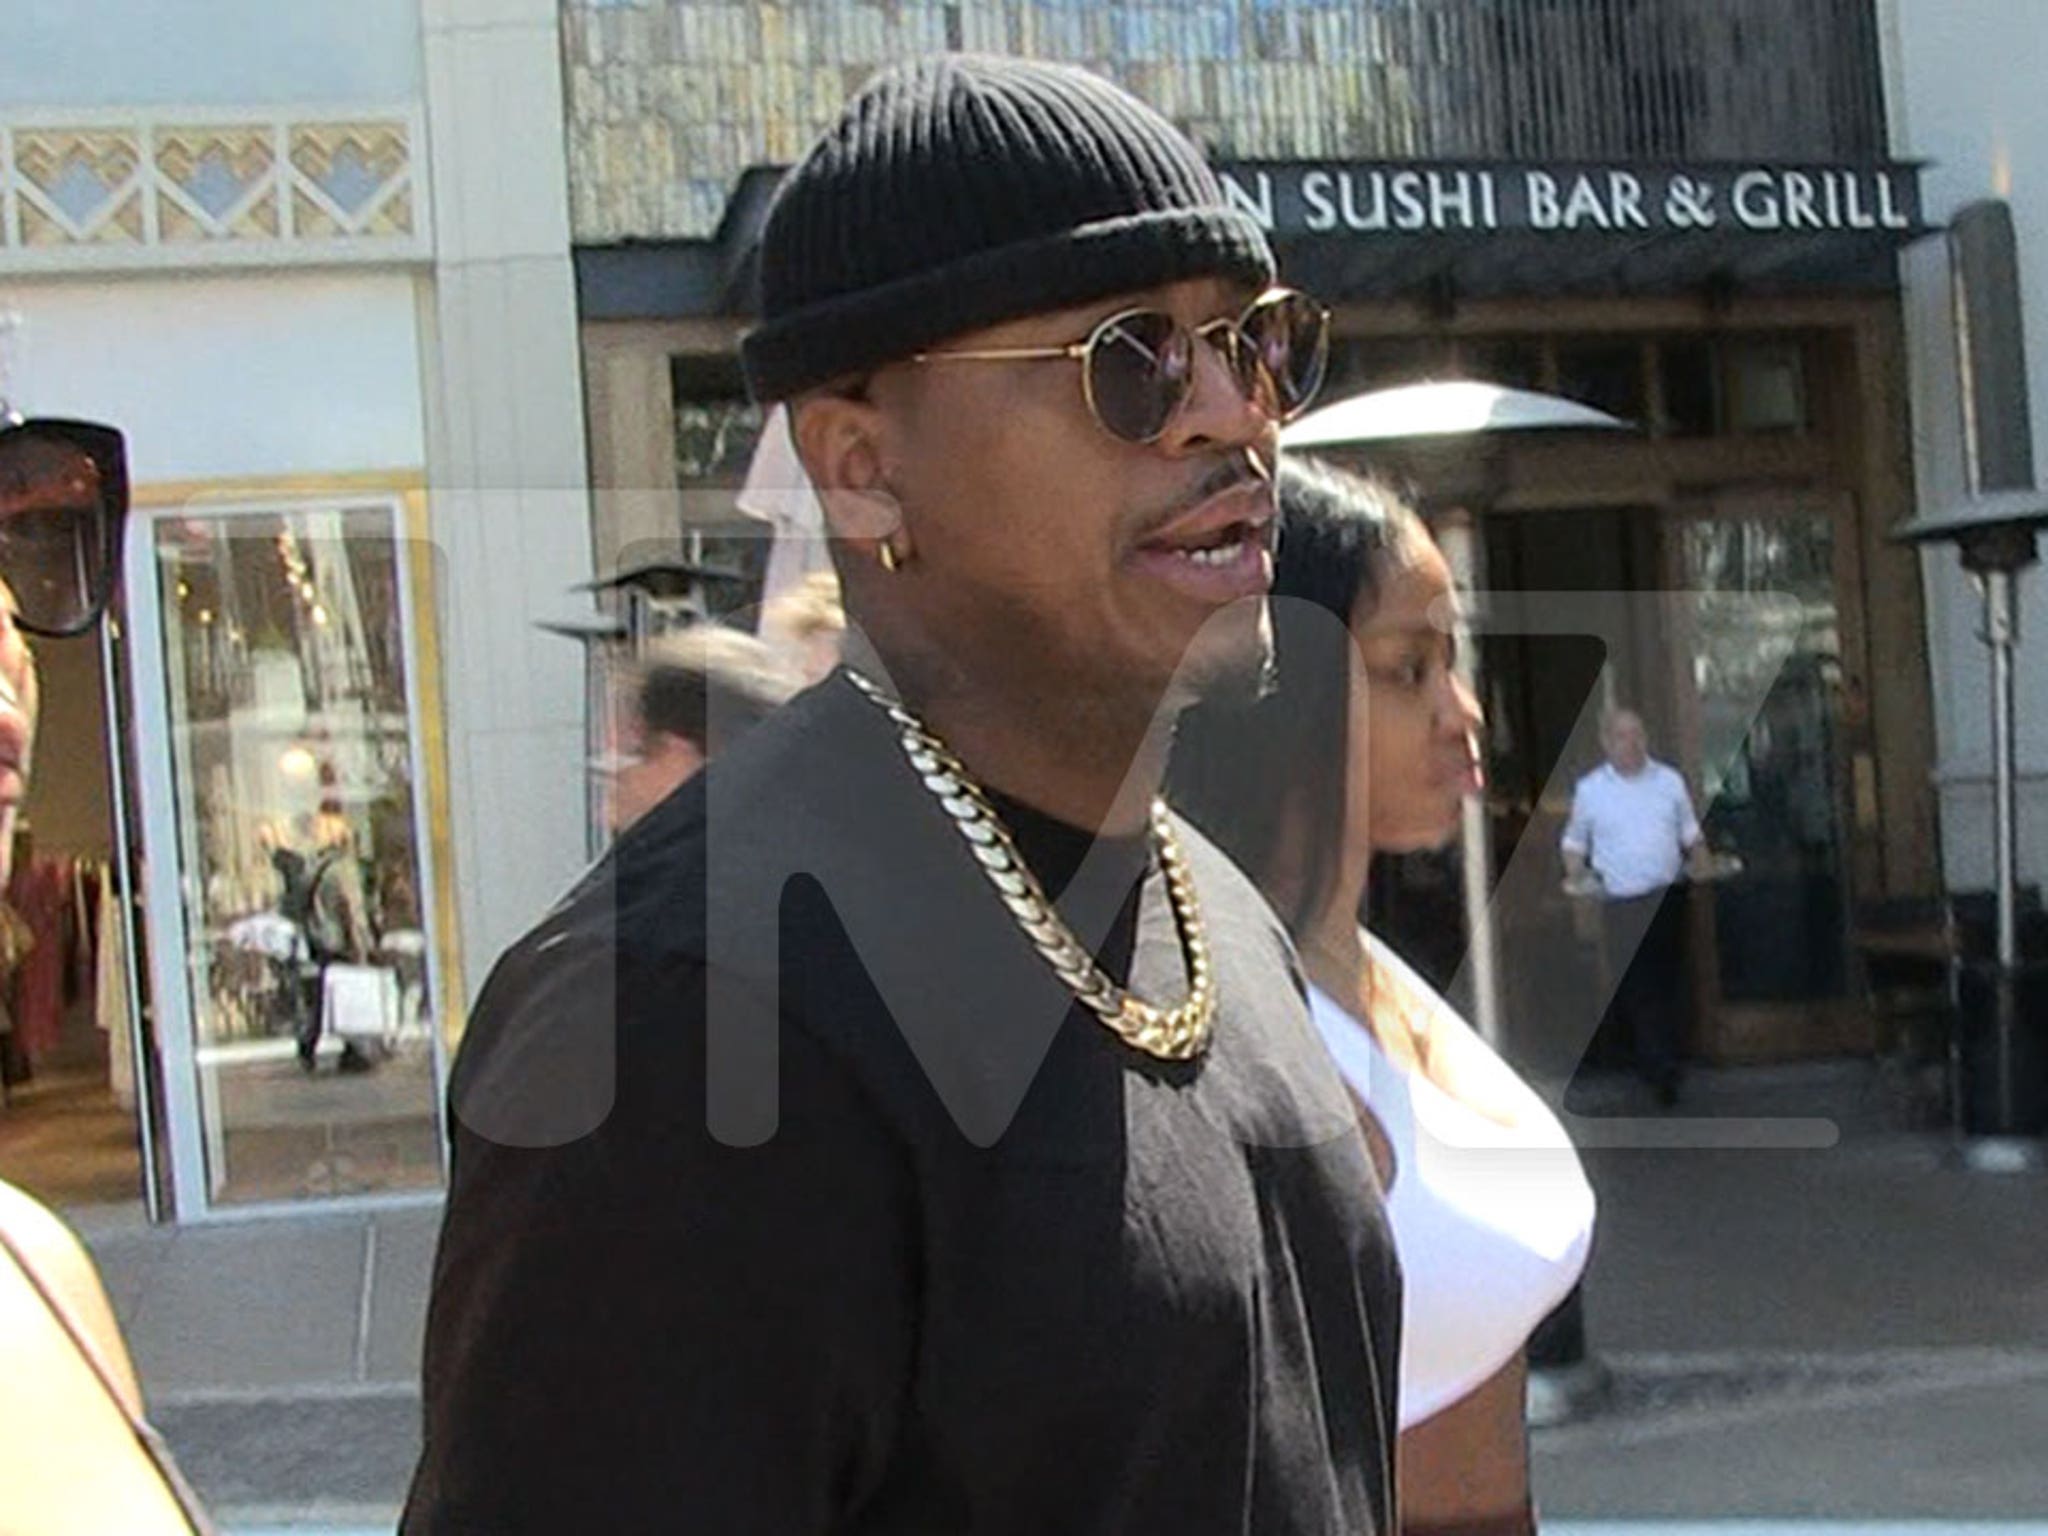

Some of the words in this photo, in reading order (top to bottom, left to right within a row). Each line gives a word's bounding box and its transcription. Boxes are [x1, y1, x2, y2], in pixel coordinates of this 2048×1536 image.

[1302, 170, 1497, 230] SUSHI
[1526, 171, 1649, 229] BAR
[1664, 173, 1717, 229] &
[1732, 170, 1908, 229] GRILL
